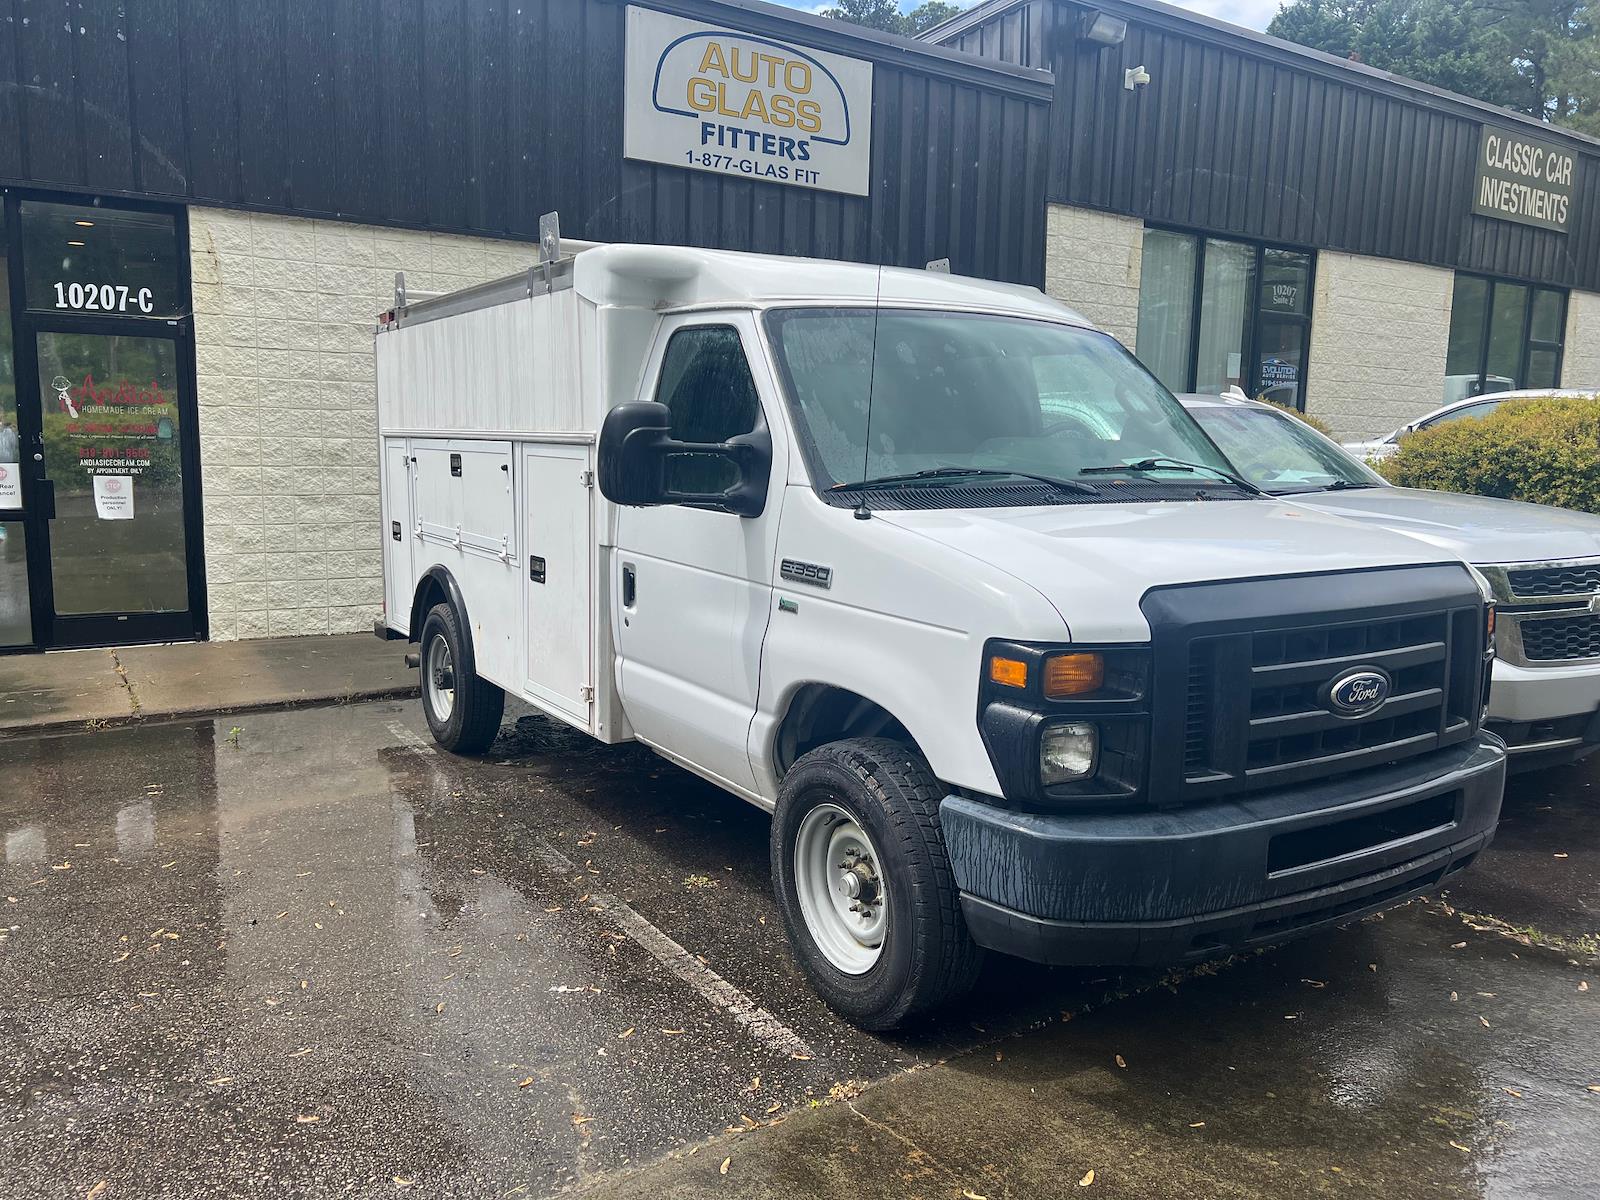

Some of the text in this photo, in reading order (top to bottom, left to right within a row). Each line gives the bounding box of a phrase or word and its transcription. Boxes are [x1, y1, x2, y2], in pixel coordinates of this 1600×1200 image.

[699, 42, 812, 94] AUTO
[687, 77, 822, 133] GLASS
[701, 121, 811, 161] FITTERS
[685, 150, 820, 184] 1-877-GLAS FIT
[1486, 135, 1573, 186] CLASSIC CAR
[1480, 176, 1569, 224] INVESTMENTS
[53, 282, 153, 313] 10207-C
[1272, 285, 1297, 297] 10207
[1273, 296, 1295, 307] Suite E
[1262, 365, 1296, 375] EVOLUTION
[81, 405, 169, 416] HOMEMADE ICE CREAM
[79, 459, 151, 467] ANDIASICECREAM.COM
[1348, 679, 1380, 703] Ford
